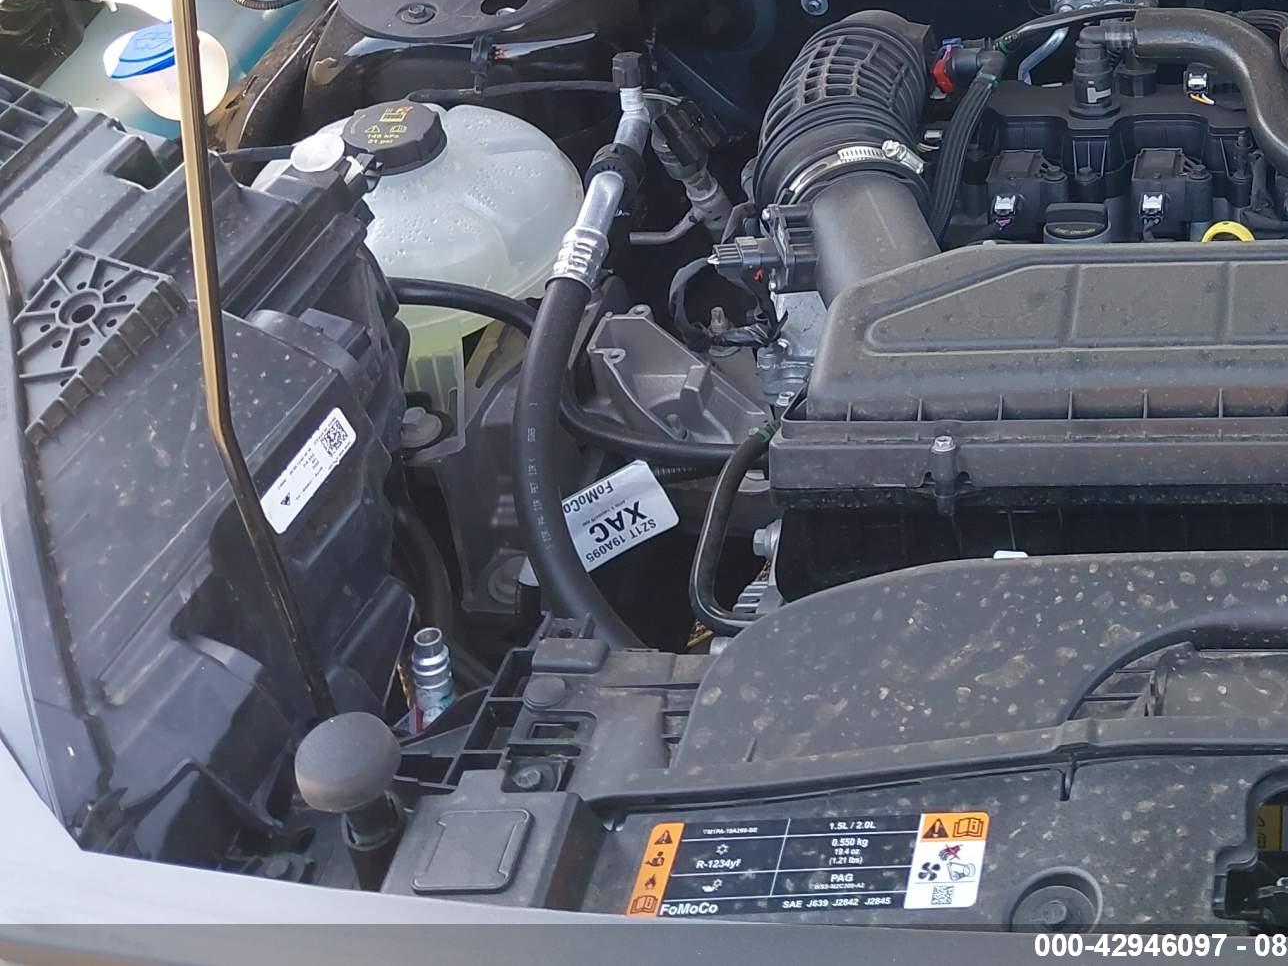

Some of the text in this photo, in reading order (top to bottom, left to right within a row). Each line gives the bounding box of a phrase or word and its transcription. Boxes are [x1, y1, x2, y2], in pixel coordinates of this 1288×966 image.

[563, 480, 614, 513] FoMoCo
[588, 500, 648, 543] XAC
[586, 518, 657, 563] SZ1T 19A095
[829, 822, 849, 830] 1.5L
[855, 821, 877, 830] 2.0L
[831, 838, 869, 848] 0.550 kg
[695, 858, 742, 869] R-1234yf
[830, 873, 854, 882] PAG
[782, 896, 892, 908] SAE J639 J2842 J2845
[659, 901, 719, 916] FoMoCo
